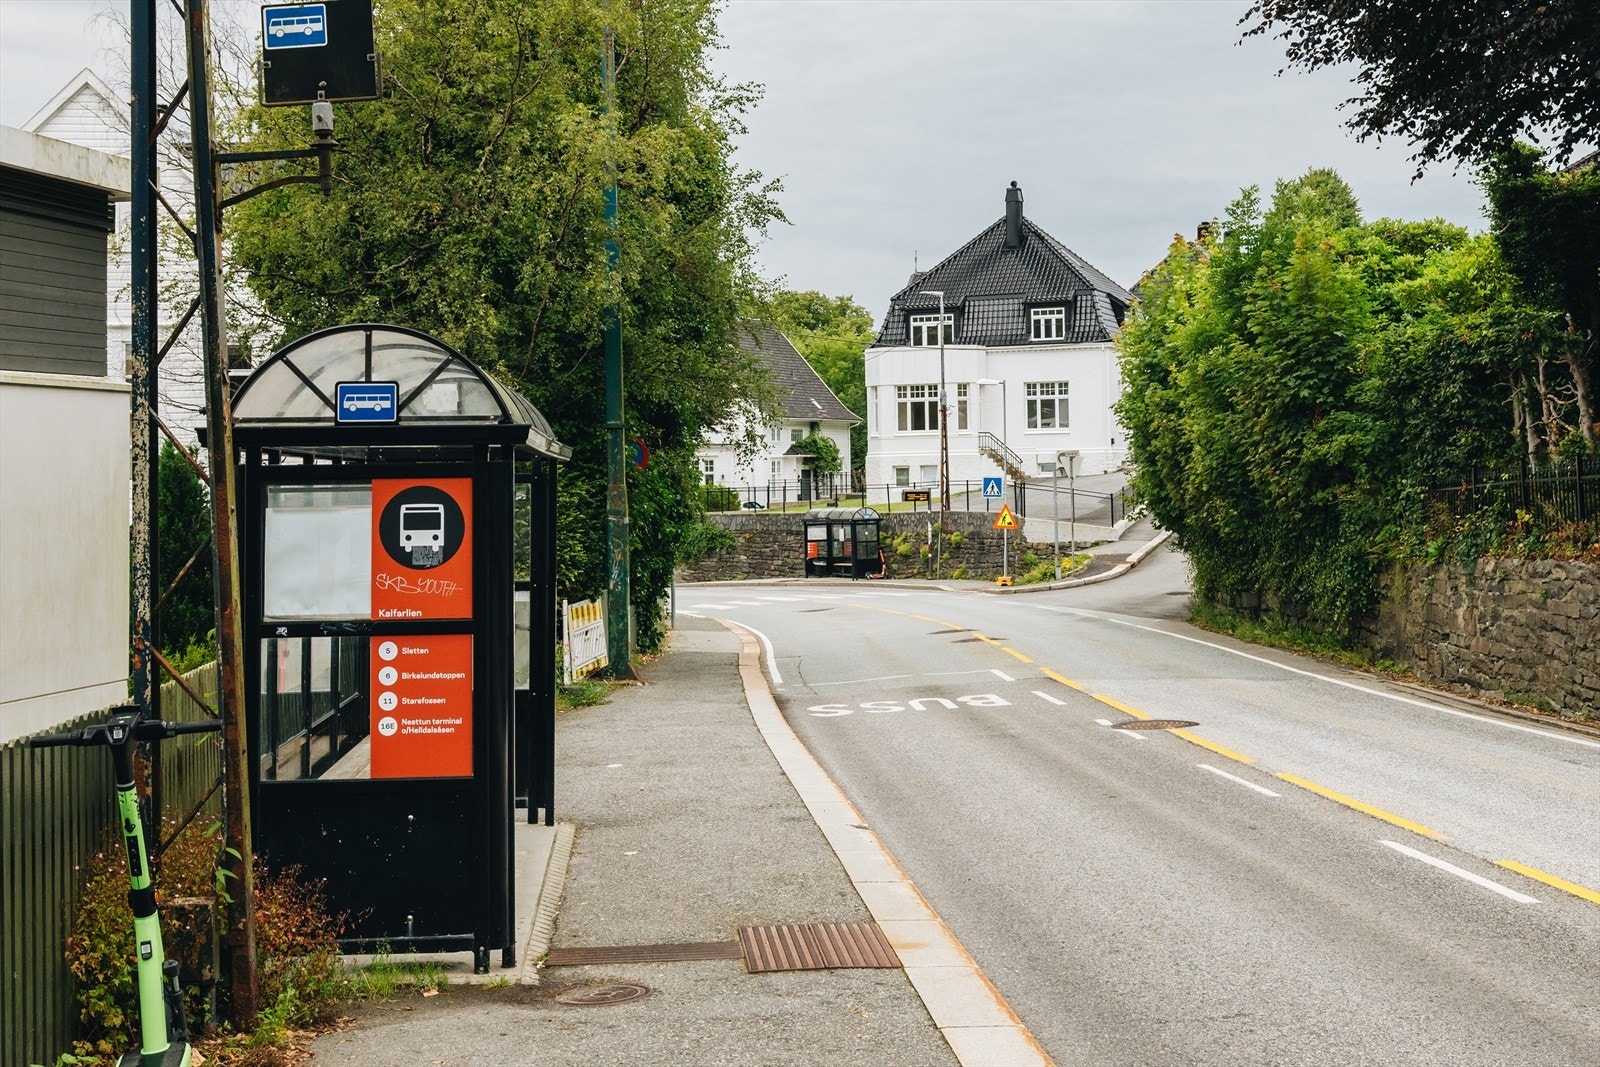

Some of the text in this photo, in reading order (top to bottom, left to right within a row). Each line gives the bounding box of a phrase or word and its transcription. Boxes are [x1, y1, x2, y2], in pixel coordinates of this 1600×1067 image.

[378, 609, 422, 617] Kalfarlien
[385, 647, 429, 655] 5 Sletten
[385, 671, 466, 681] 6 Birkelundstoppen
[401, 697, 446, 705] Starefossen
[806, 693, 1013, 717] BUSS
[381, 717, 463, 730] 16E Nesttun terminal
